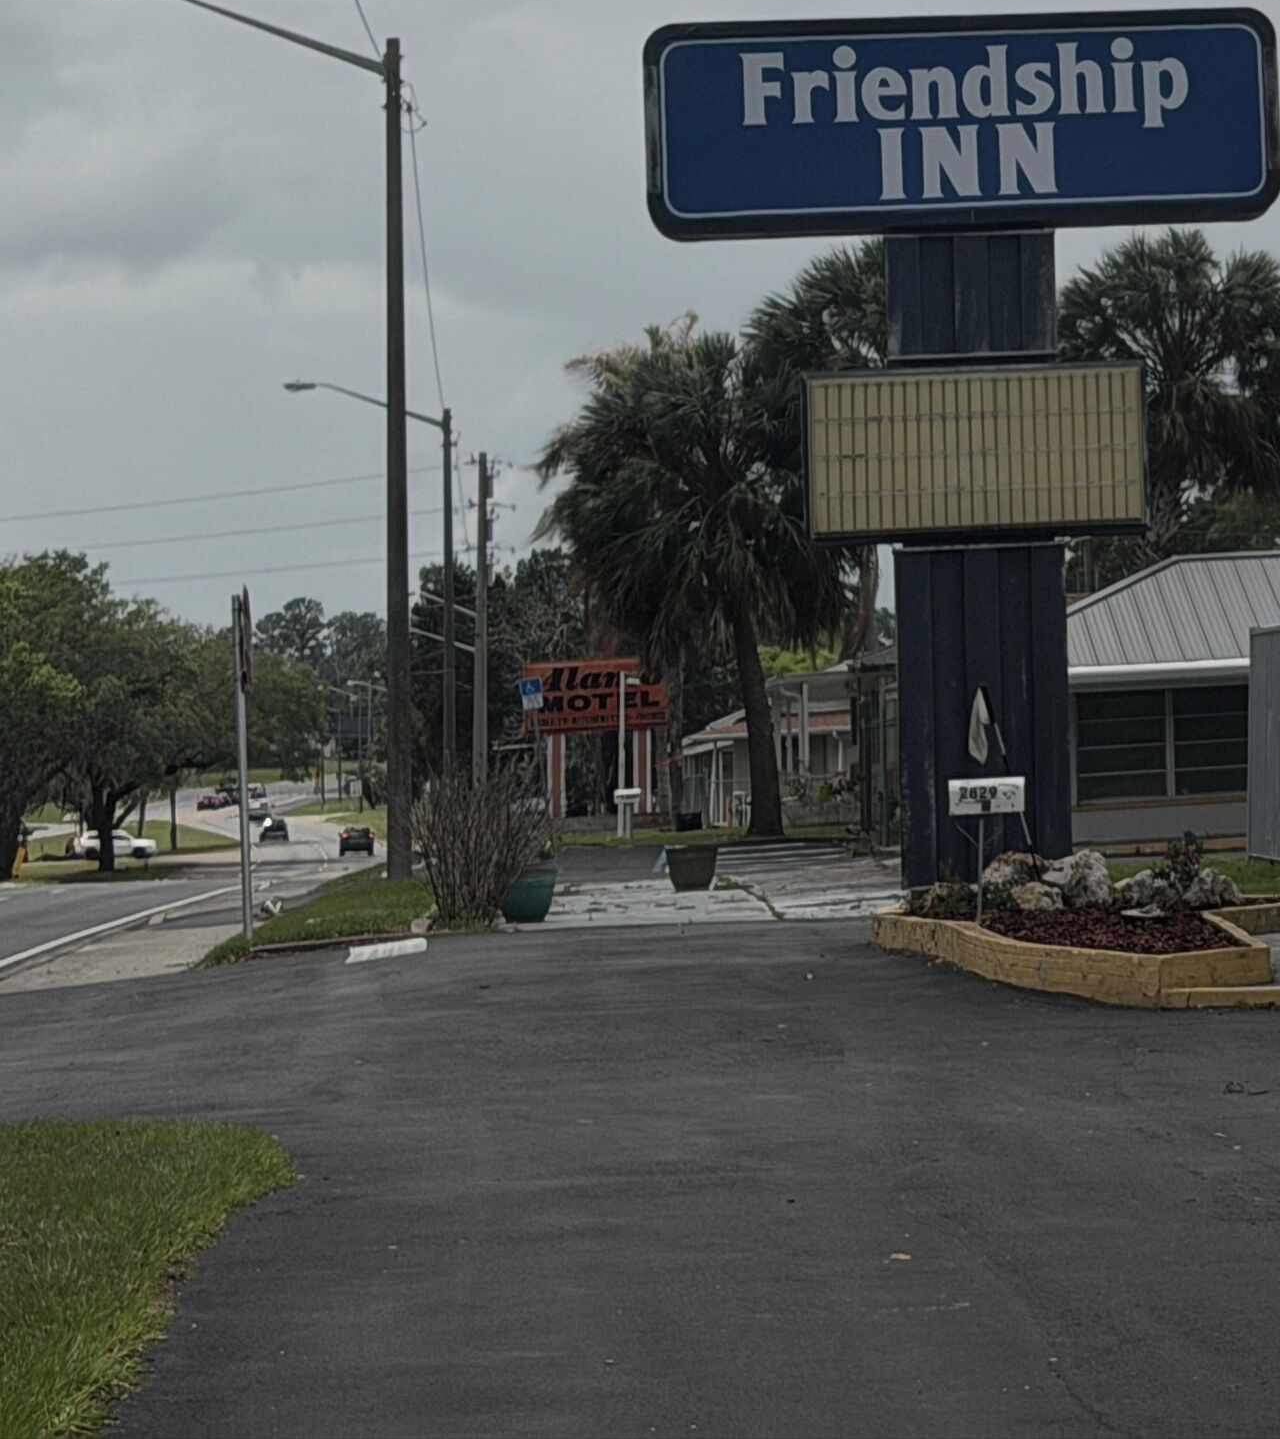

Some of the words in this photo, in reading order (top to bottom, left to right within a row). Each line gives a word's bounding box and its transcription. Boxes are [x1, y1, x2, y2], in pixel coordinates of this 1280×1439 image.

[738, 36, 1190, 129] Friendship
[876, 121, 1060, 201] INN
[538, 690, 660, 714] MOTEL
